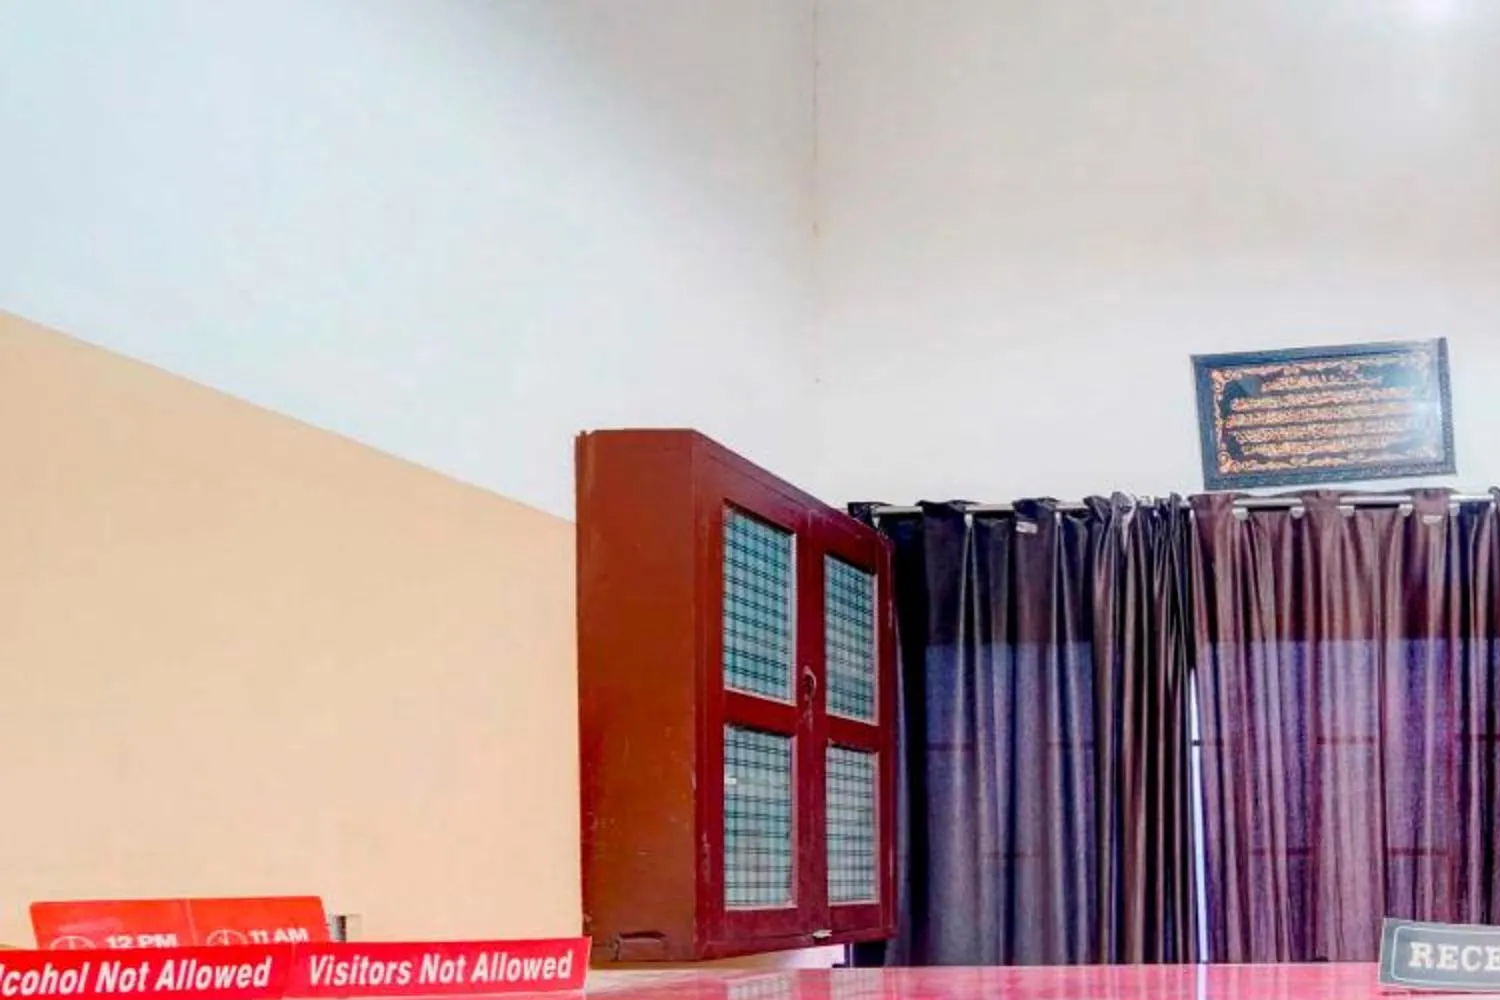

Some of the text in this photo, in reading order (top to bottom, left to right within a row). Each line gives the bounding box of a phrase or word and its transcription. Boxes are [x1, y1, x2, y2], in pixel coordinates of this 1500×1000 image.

[137, 933, 177, 949] PM
[274, 927, 309, 943] AM
[95, 960, 149, 992] Not
[155, 955, 273, 992] Allowed
[309, 949, 573, 986] Visitors Not Allowed
